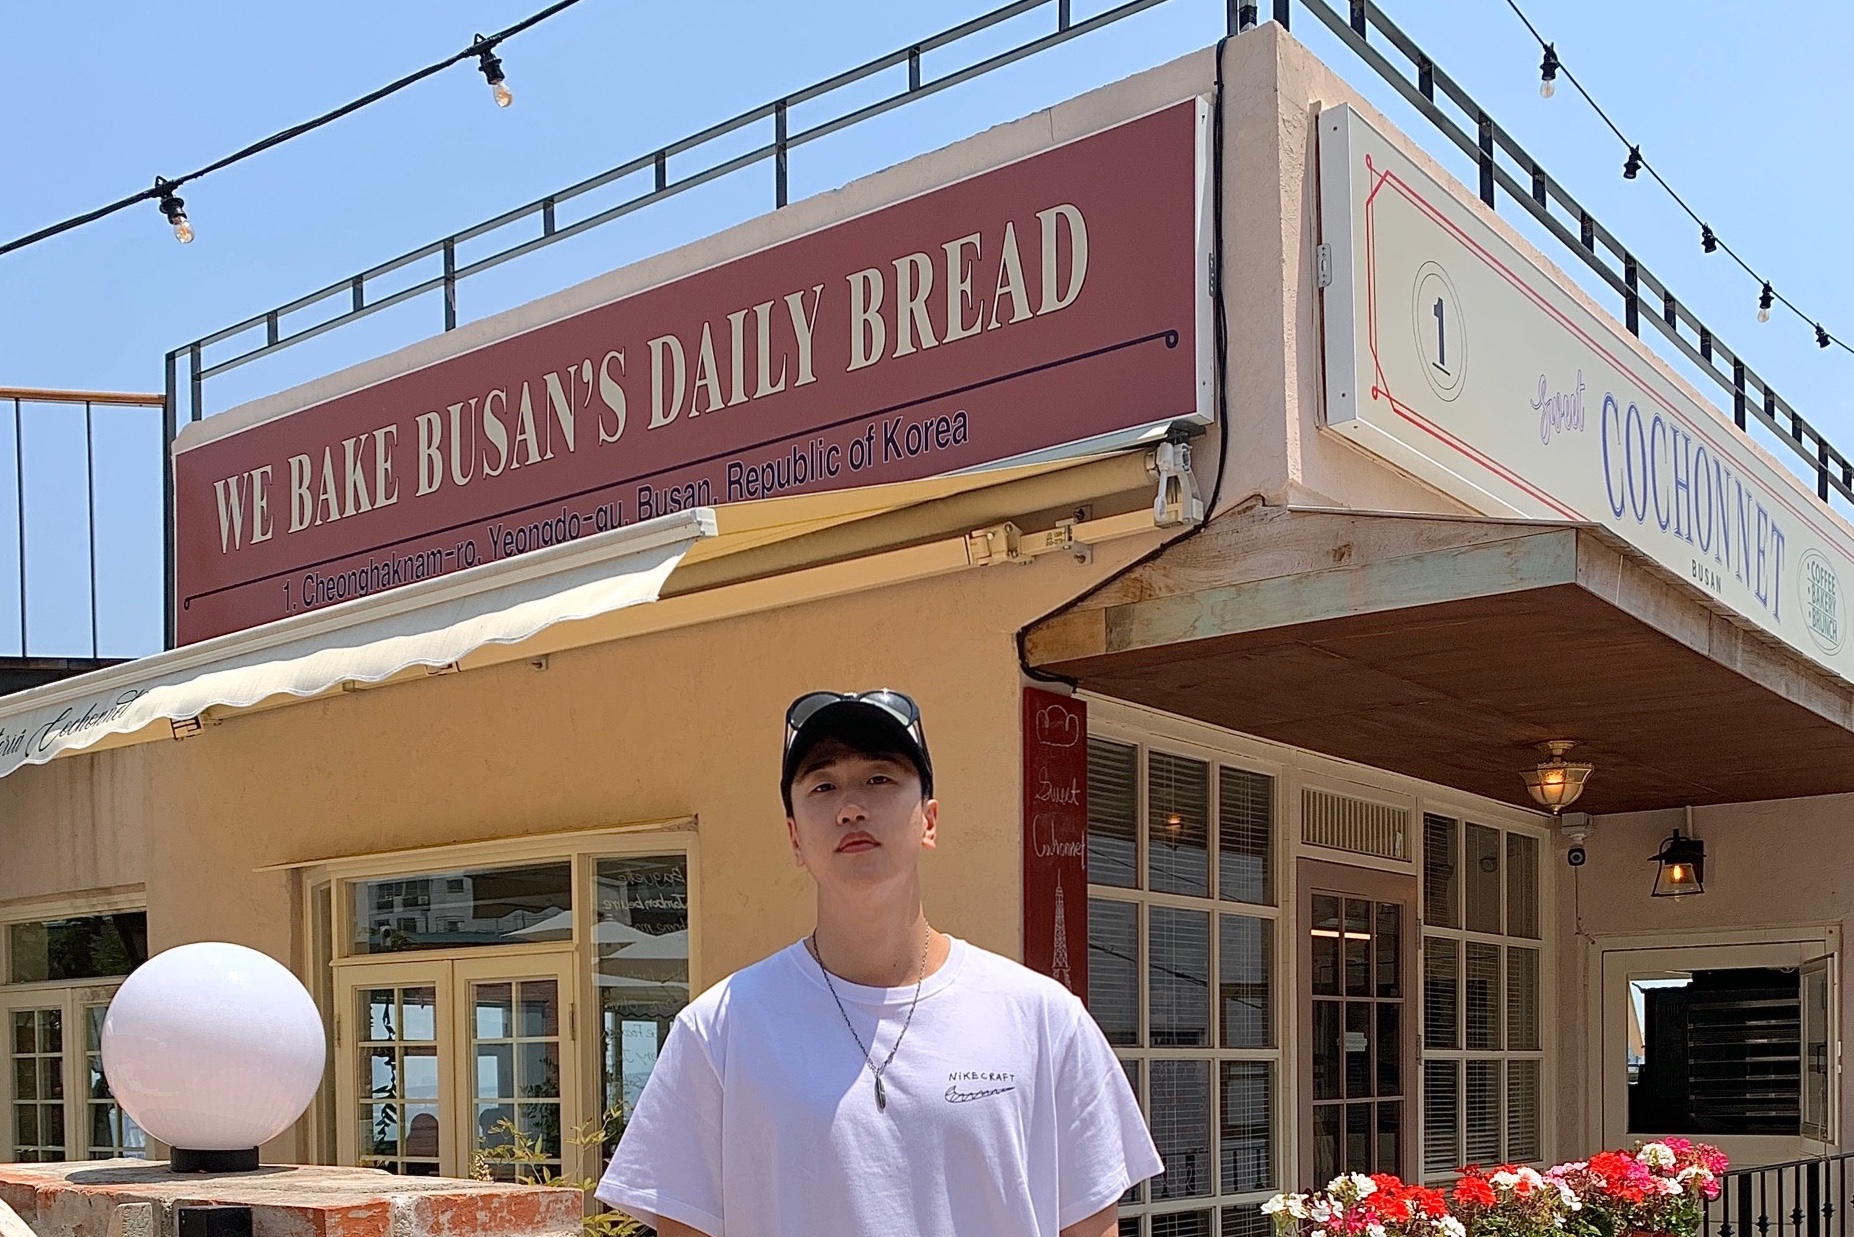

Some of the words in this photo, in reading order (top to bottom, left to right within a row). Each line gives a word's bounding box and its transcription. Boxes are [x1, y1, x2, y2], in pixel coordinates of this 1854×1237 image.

[213, 465, 274, 554] WE
[287, 424, 399, 534] BAKE
[415, 347, 627, 497] BUSAN'S
[647, 283, 826, 430] DAILY
[846, 203, 1089, 373] BREAD
[727, 438, 841, 500] Republic
[849, 422, 875, 472] of
[883, 409, 969, 463] Korea
[1601, 391, 1785, 625] COCHONNET
[1691, 558, 1723, 594] BUSAN
[1811, 560, 1836, 596] COFFEE
[1811, 582, 1837, 619] BAKERY
[1811, 606, 1838, 642] BRUNCH
